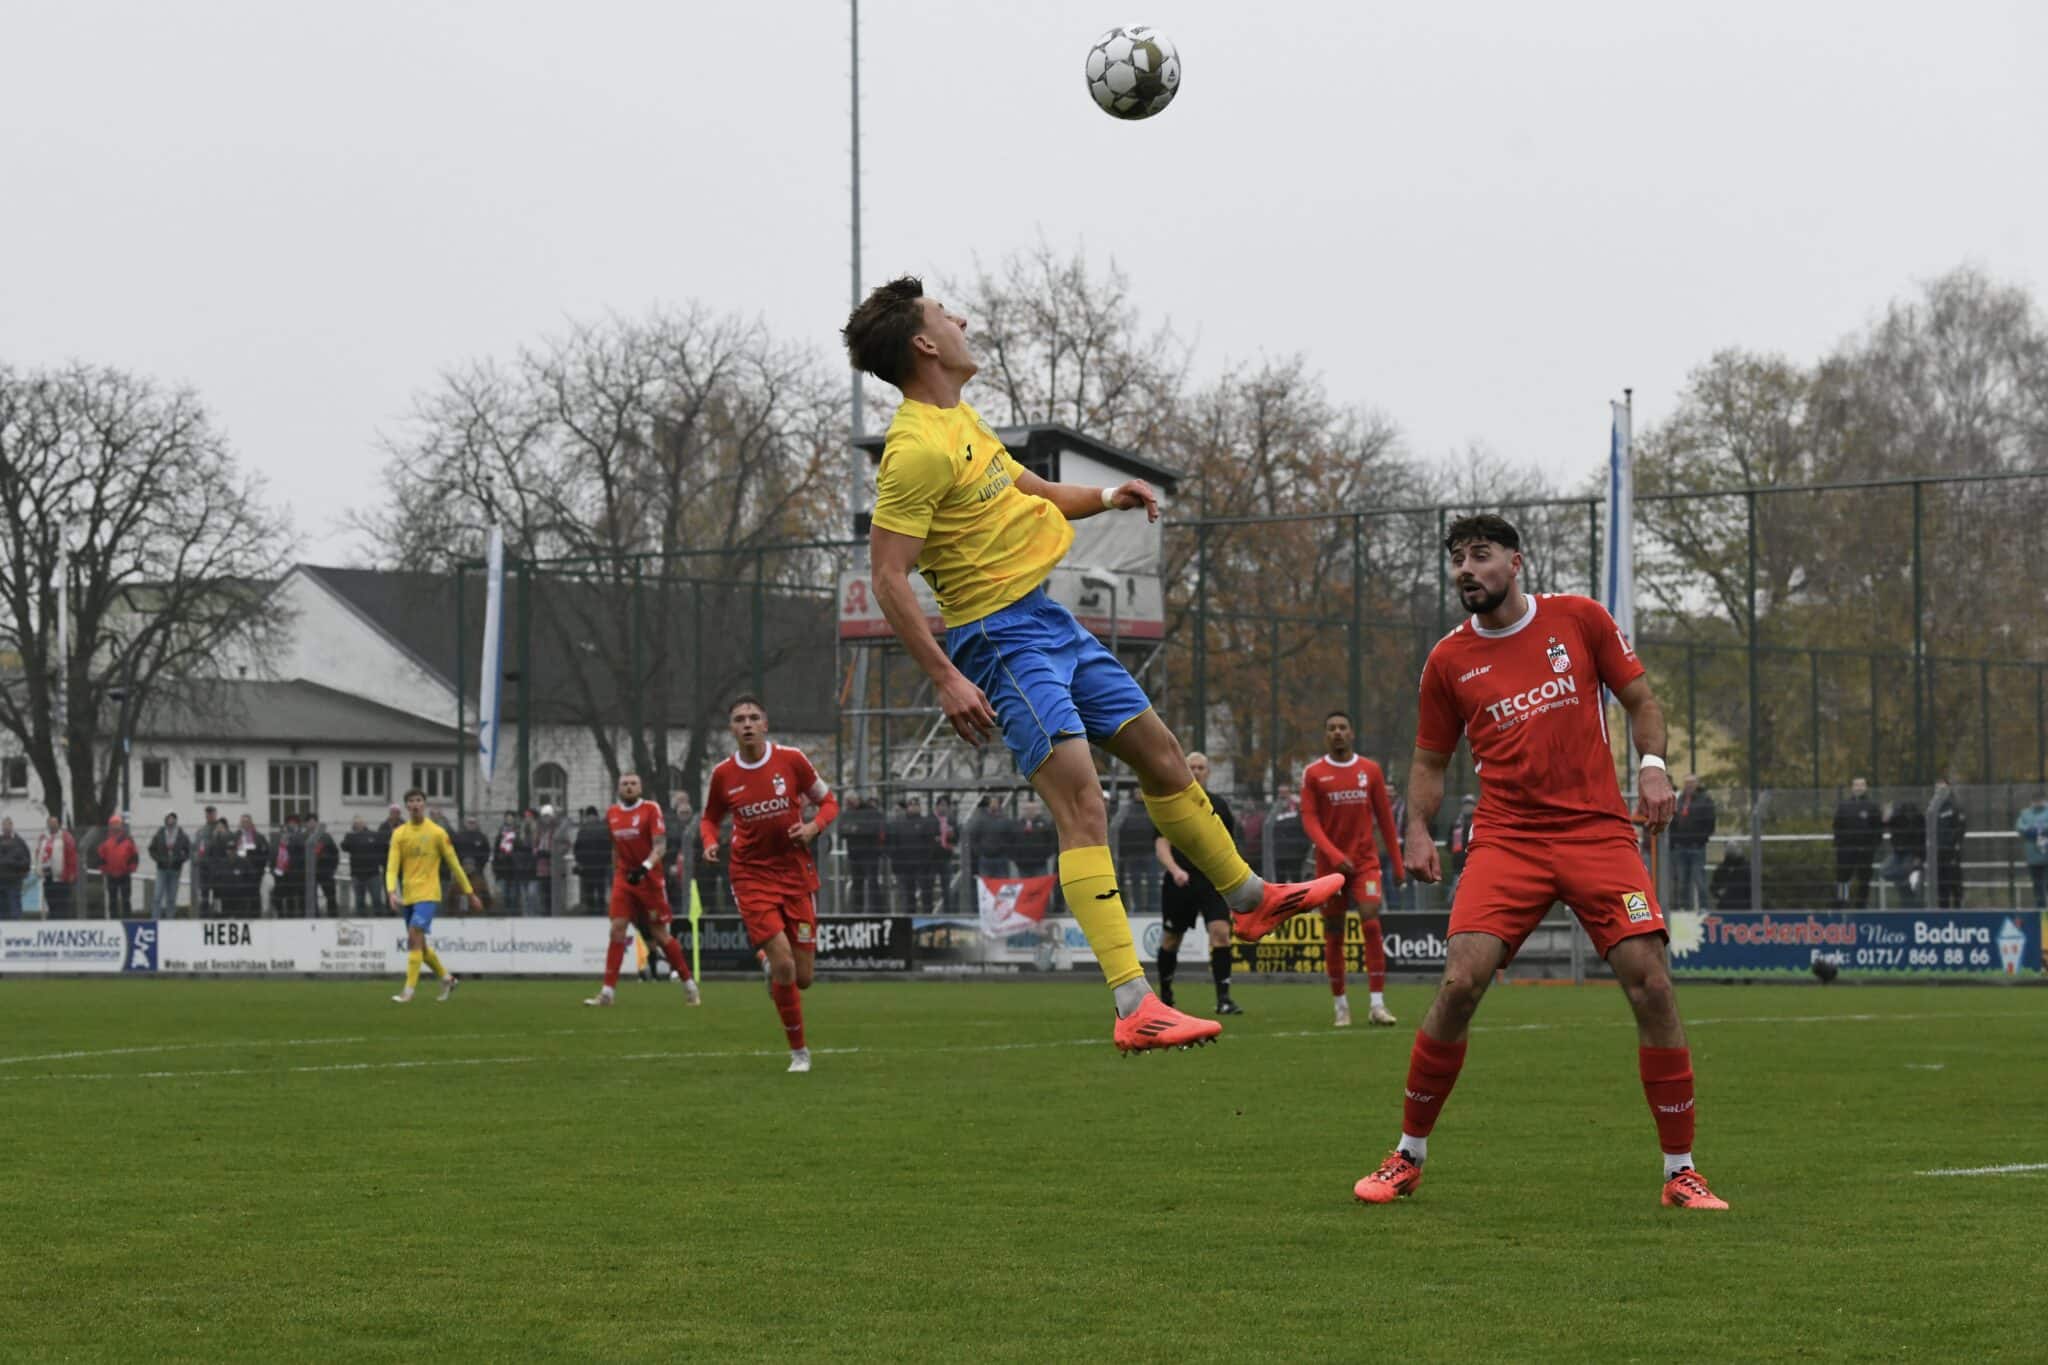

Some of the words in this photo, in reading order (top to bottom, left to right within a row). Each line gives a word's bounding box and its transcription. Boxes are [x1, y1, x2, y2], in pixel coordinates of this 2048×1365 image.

[1486, 675, 1577, 722] TECCON
[738, 796, 790, 817] TECCON
[203, 923, 252, 946] HEBA
[1703, 914, 1857, 945] Trockenbau
[1859, 923, 1907, 944] Nico
[1914, 920, 1990, 945] Badura
[491, 937, 573, 954] Luckenwalde
[1856, 948, 1904, 965] 0171/
[1908, 948, 1938, 965] 866
[1943, 948, 1963, 965] 88
[1969, 948, 1990, 965] 66
